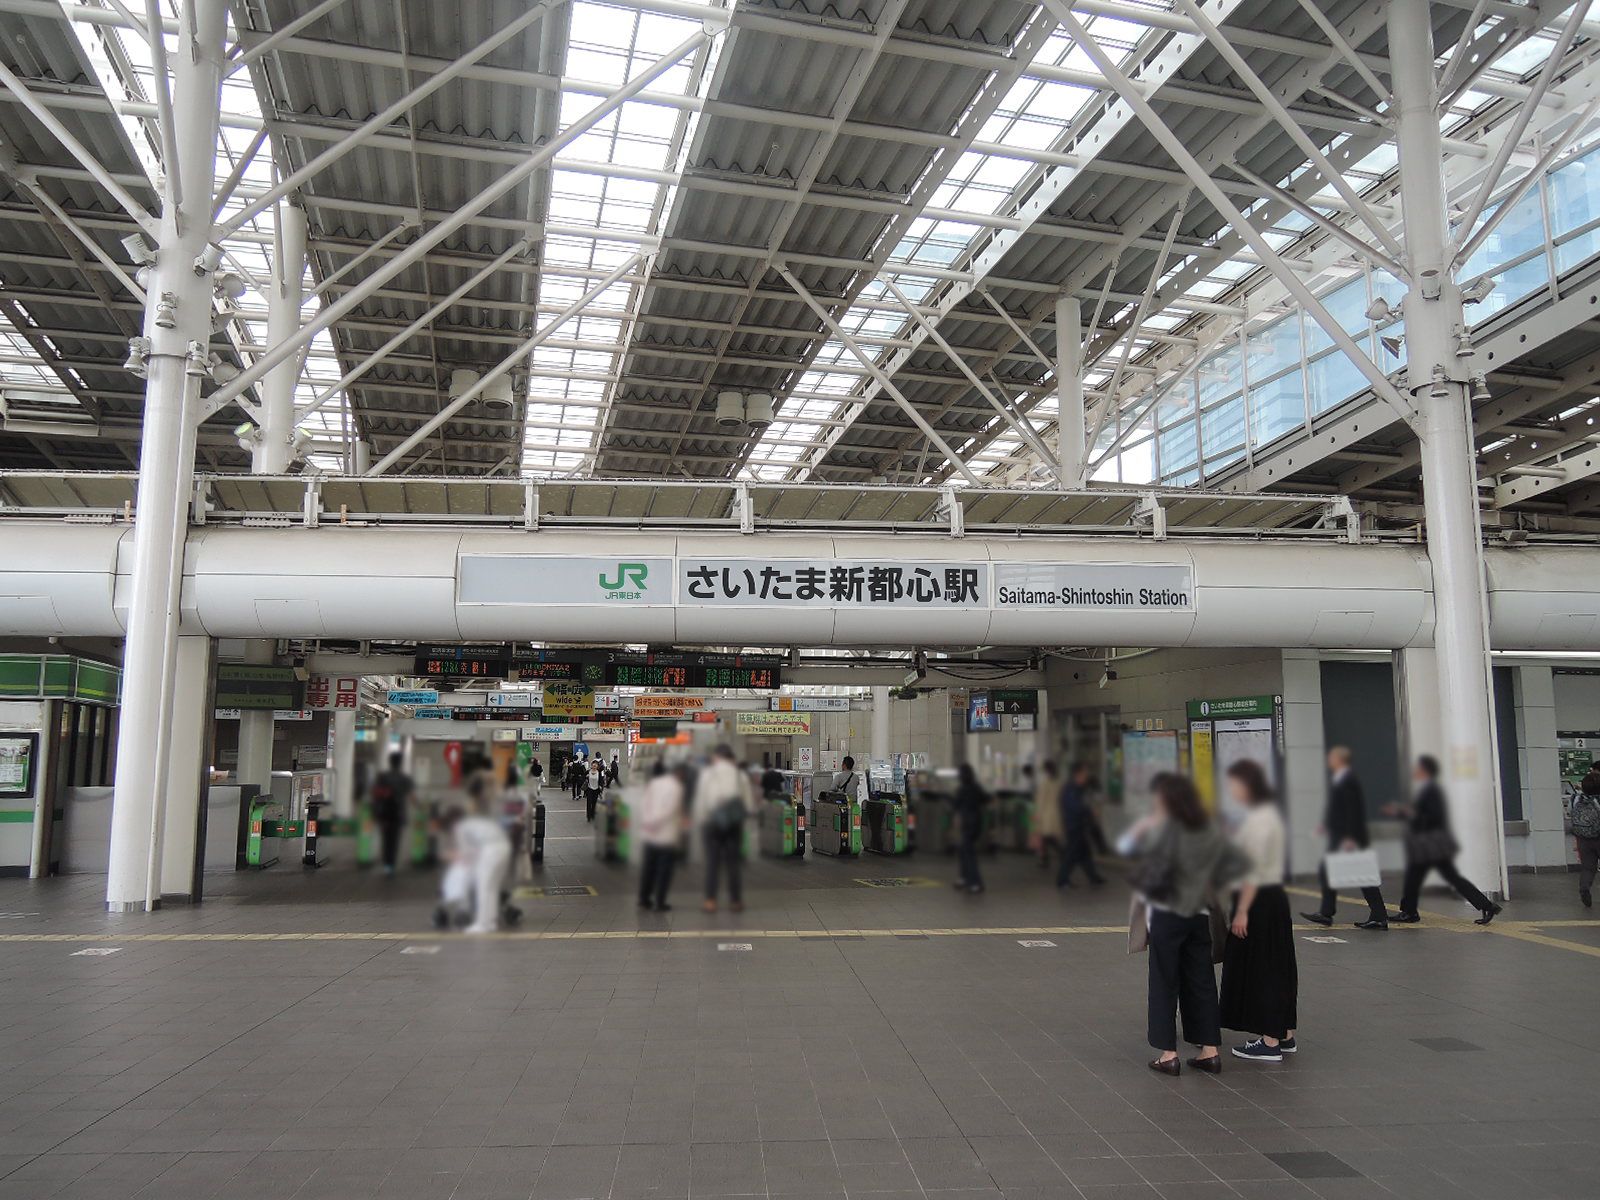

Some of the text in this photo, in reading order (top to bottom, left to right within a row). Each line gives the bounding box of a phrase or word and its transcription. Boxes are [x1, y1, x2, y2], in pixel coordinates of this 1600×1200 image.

[599, 563, 648, 590] JR
[687, 565, 980, 603] さいたま新都心駅
[605, 591, 642, 599] JR東日本
[999, 587, 1187, 606] Saitama-Shintoshin Station
[607, 652, 615, 663] 3
[697, 656, 705, 665] 4
[307, 677, 358, 692] 出口
[556, 696, 573, 704] wide
[1578, 739, 1583, 747] 2
